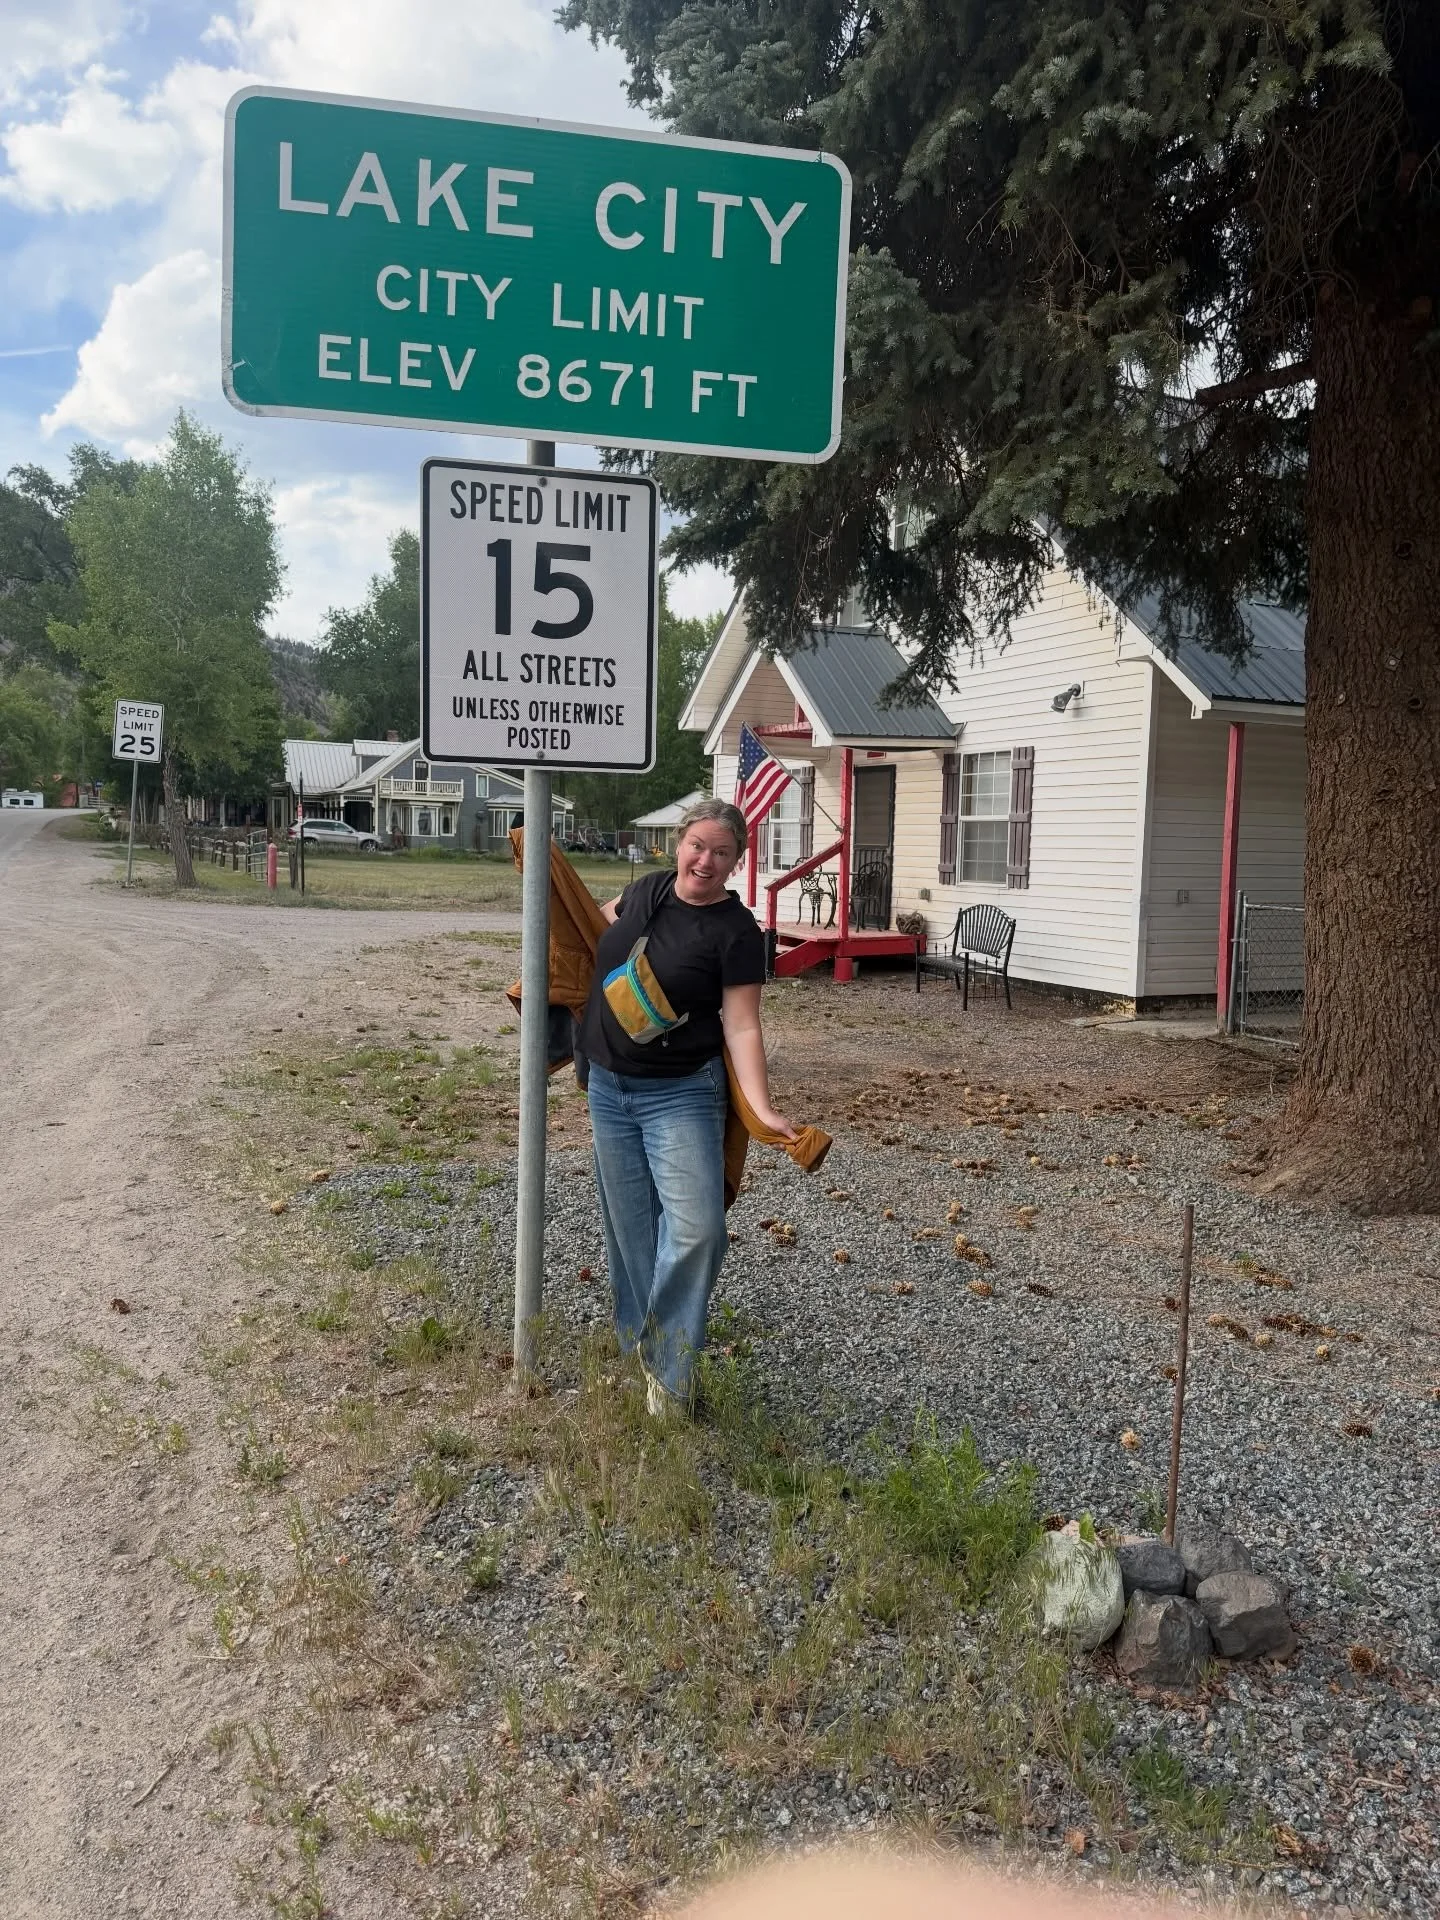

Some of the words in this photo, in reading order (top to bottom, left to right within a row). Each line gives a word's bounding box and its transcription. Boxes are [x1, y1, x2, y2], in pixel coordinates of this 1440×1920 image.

[279, 141, 534, 238] LAKE
[595, 181, 807, 265] CITY
[376, 264, 512, 320] CITY
[552, 282, 704, 340] LIMIT
[318, 333, 476, 392] ELEV
[516, 353, 654, 409] 8671
[691, 370, 758, 417] FT
[450, 479, 543, 525] SPEED
[555, 488, 631, 533] LIMIT
[486, 538, 594, 640] 15
[462, 649, 508, 682] ALL
[519, 652, 617, 688] STREETS
[120, 706, 160, 719] SPEED
[123, 720, 155, 732] LIMIT
[452, 696, 520, 721] UNLESS
[528, 700, 625, 726] OTHERWISE
[119, 734, 156, 756] 25
[507, 726, 571, 750] POSTED
